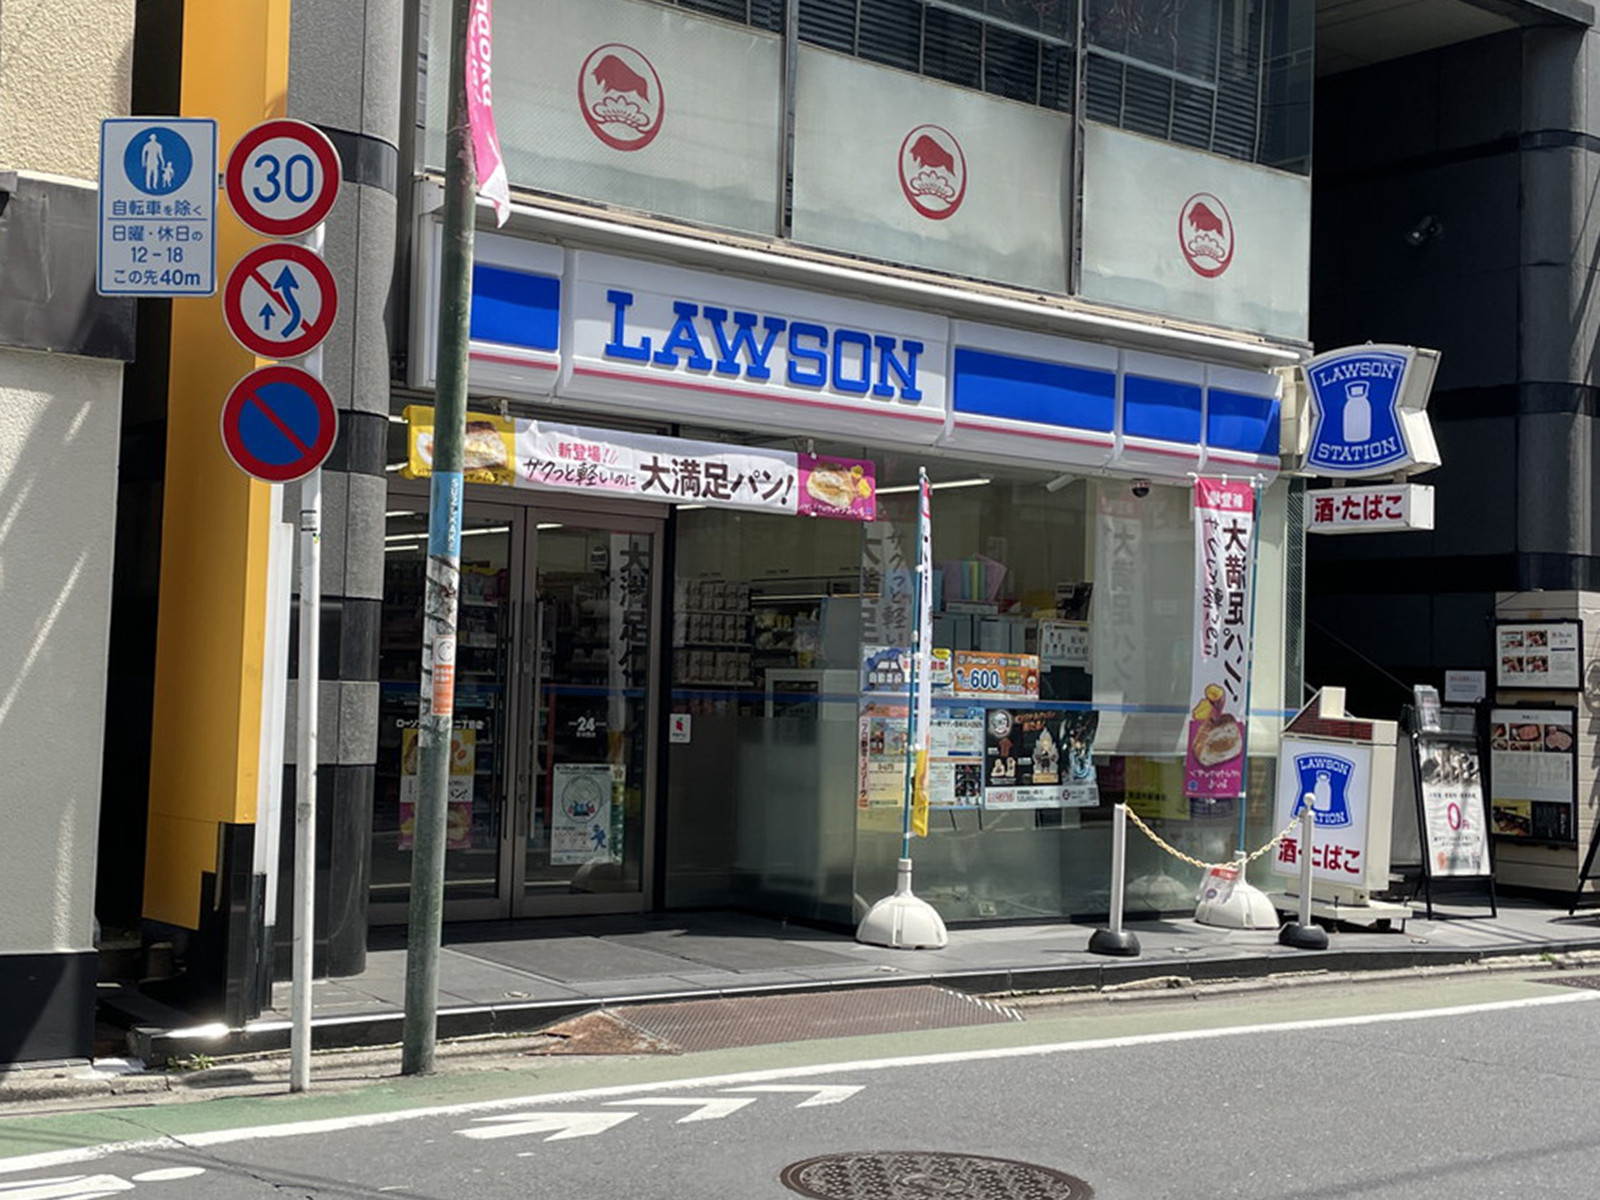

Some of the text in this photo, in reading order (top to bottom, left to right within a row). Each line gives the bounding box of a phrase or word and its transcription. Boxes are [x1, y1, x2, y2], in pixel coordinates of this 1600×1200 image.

[253, 154, 314, 203] 30
[112, 200, 202, 216] 自転車を除く
[112, 225, 203, 242] 日曜・休日の
[114, 270, 200, 286] この先40m
[604, 289, 924, 402] LAWSON
[1319, 362, 1396, 386] LAWSON
[1318, 437, 1397, 462] STATION
[640, 455, 794, 505] 大満足パン!
[1314, 494, 1403, 523] 酒・たばこ
[970, 669, 999, 690] 600
[577, 716, 596, 732] 24
[1299, 757, 1349, 776] LAWSON
